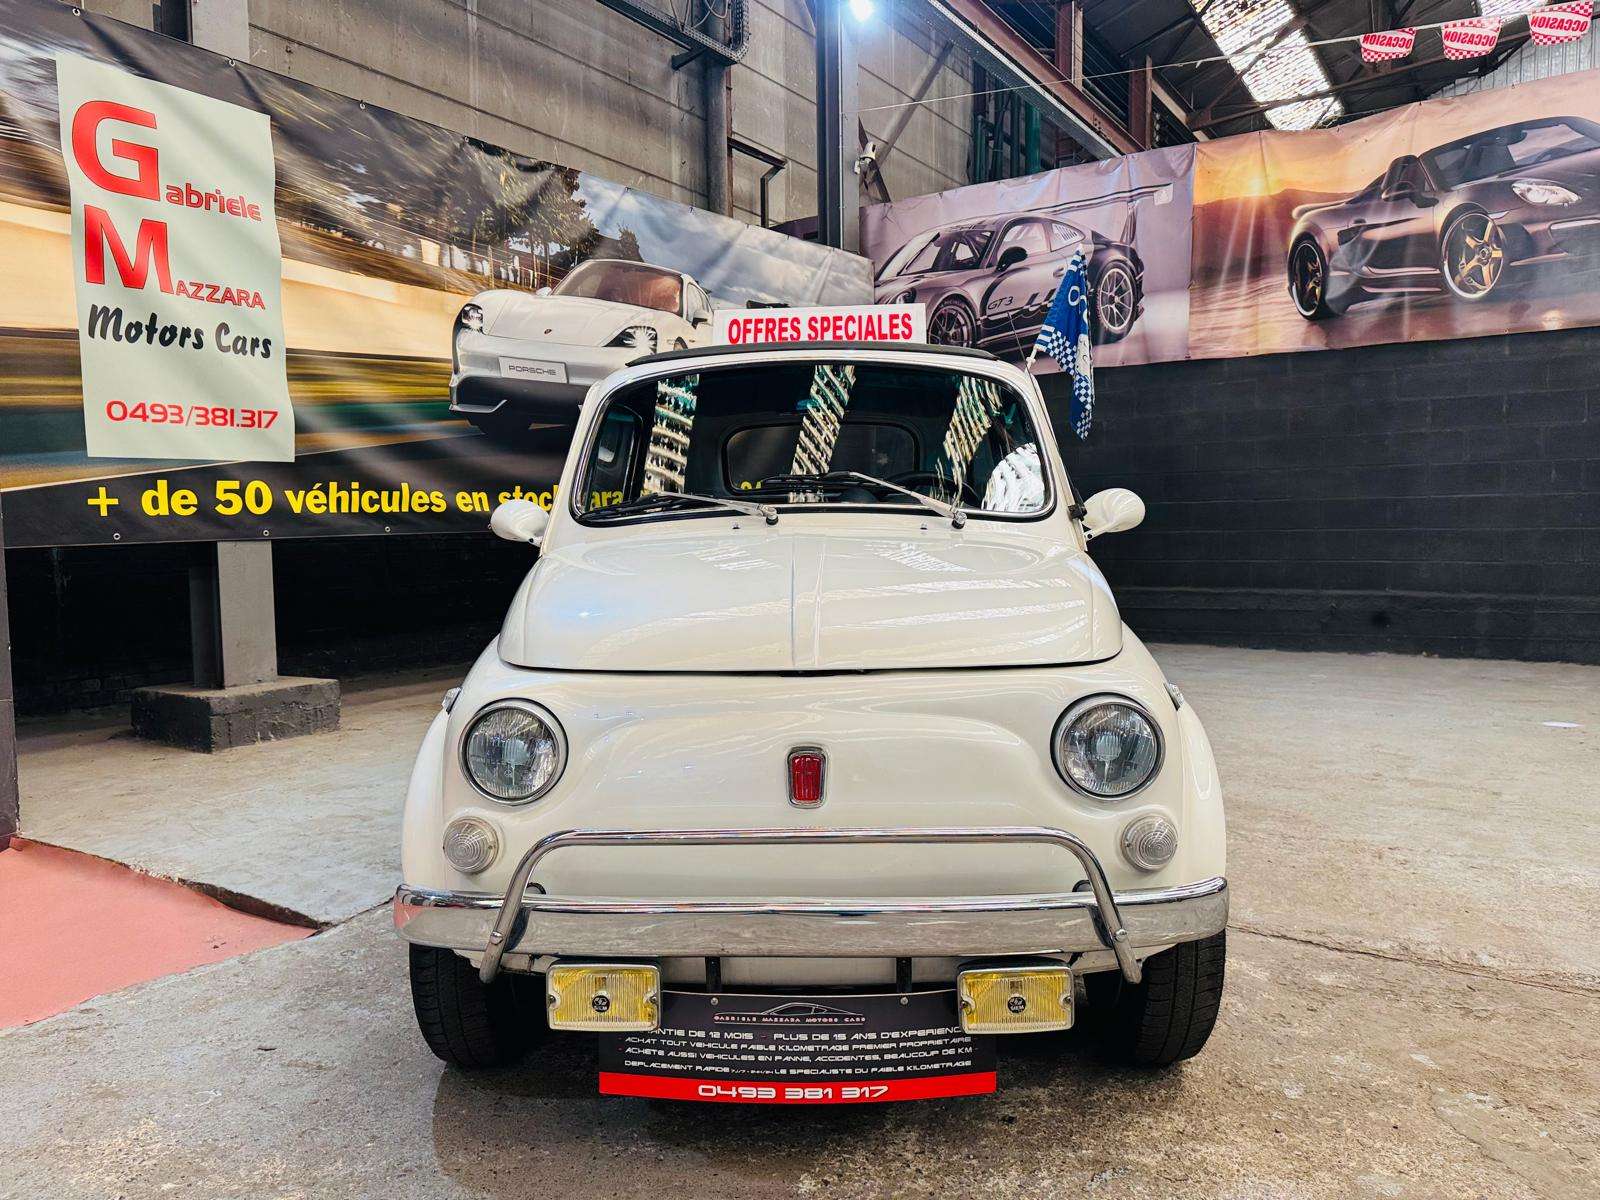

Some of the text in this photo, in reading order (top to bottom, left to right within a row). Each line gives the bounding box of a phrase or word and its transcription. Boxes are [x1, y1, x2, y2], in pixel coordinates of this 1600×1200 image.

[988, 296, 1014, 310] GT3
[88, 303, 272, 359] Motors Cars
[728, 313, 913, 344] OFFRES SPECIALES
[508, 365, 557, 376] PORSCHE
[106, 400, 279, 429] 0493/381.317
[87, 480, 560, 517] + de 50 véhicules en stoc
[688, 1030, 706, 1038] DE
[724, 1032, 754, 1040] MOIS
[773, 1033, 808, 1041] PLUS
[811, 1033, 830, 1041] DE
[850, 1032, 877, 1040] ANS
[880, 1026, 961, 1039] D'EXPERIENC
[660, 1039, 687, 1047] TOUT
[689, 1041, 738, 1050] VEHICULE
[740, 1043, 776, 1051] FAIBLE
[778, 1044, 850, 1052] KILOMETRAGE
[852, 1042, 897, 1051] PREMIER
[899, 1036, 972, 1048] PROPRIETAIRE
[625, 1047, 665, 1056] ACHETE
[699, 1052, 755, 1061] VEHICULES
[883, 1050, 939, 1060] BEAUCOUP
[941, 1048, 956, 1056] DE
[957, 1046, 973, 1054] KM
[624, 1060, 693, 1071] DEPLACEMENT
[695, 1065, 730, 1073] RAPIDE
[870, 1065, 905, 1073] FAIBLE
[906, 1060, 972, 1071] KILOMETRAGE
[698, 1084, 889, 1100] 0493 381 317
